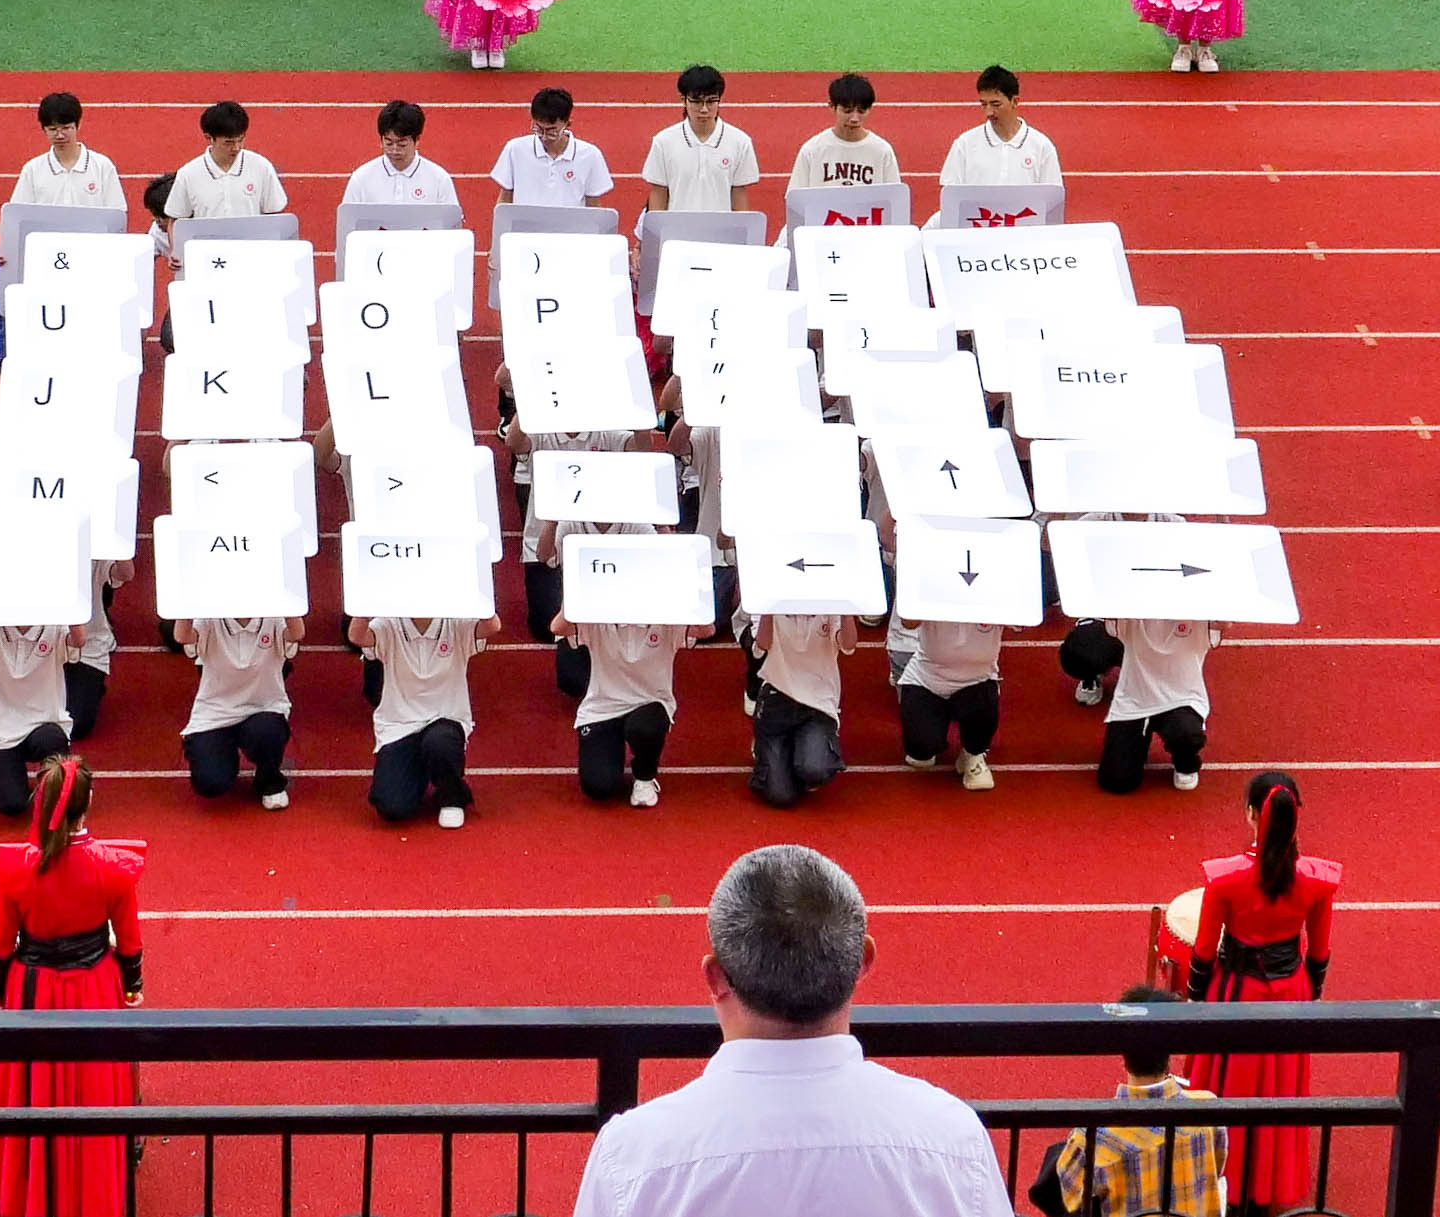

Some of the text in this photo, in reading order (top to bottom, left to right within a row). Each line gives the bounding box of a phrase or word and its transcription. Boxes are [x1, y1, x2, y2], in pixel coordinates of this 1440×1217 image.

[823, 162, 874, 185] LNHC
[54, 252, 70, 270] &
[957, 253, 1078, 277] backspce
[41, 304, 66, 331] U
[360, 302, 389, 330] O
[536, 298, 560, 324] P
[203, 370, 229, 395] K
[365, 371, 390, 400] L
[1057, 367, 1129, 385] Enter
[34, 377, 53, 406] J
[566, 463, 583, 478] ?
[32, 476, 65, 499] M
[210, 535, 250, 553] Alt
[370, 542, 421, 558] Ctrl
[592, 559, 616, 574] fn
